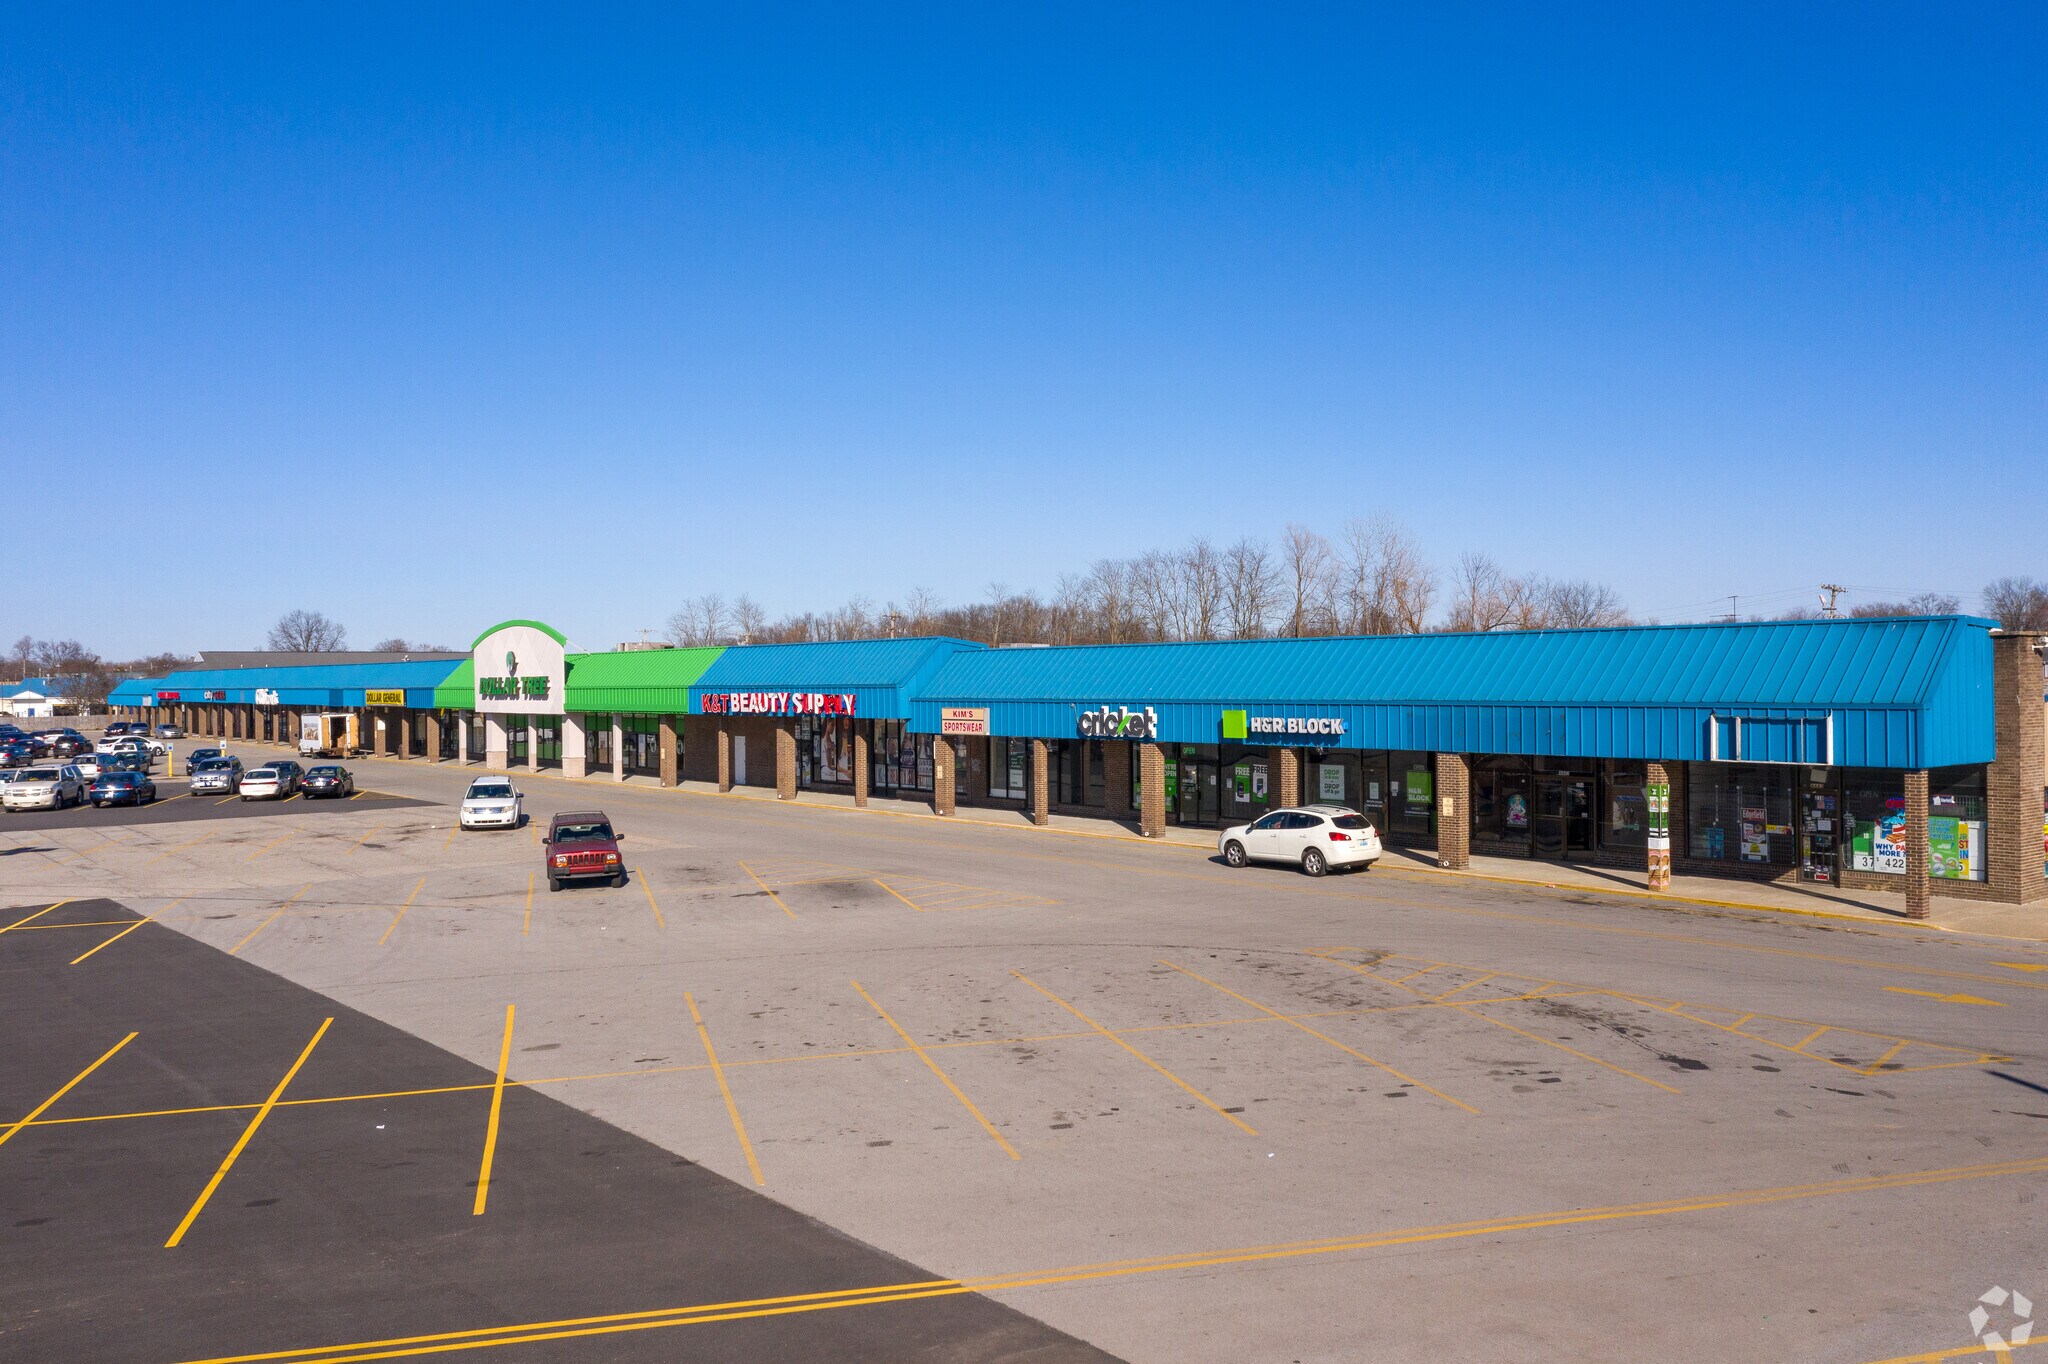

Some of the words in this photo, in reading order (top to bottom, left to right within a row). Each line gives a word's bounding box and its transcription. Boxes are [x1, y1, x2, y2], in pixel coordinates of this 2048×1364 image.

[479, 676, 519, 695] DOLLAR
[520, 676, 549, 695] TREE
[366, 692, 382, 703] DOLLAR
[383, 692, 402, 703] GENERAL
[701, 693, 729, 714] K&T
[730, 692, 790, 714] BEAUTY
[952, 710, 974, 718] KIM'S
[943, 722, 983, 732] SPORTSWEAR
[1078, 706, 1157, 739] cricket
[1251, 717, 1286, 734] H&R
[1287, 717, 1345, 735] BLOCK
[1235, 767, 1250, 775] FREE
[1253, 766, 1268, 774] FREE
[1742, 809, 1765, 819] Edgefield
[1885, 858, 1905, 869] 422
